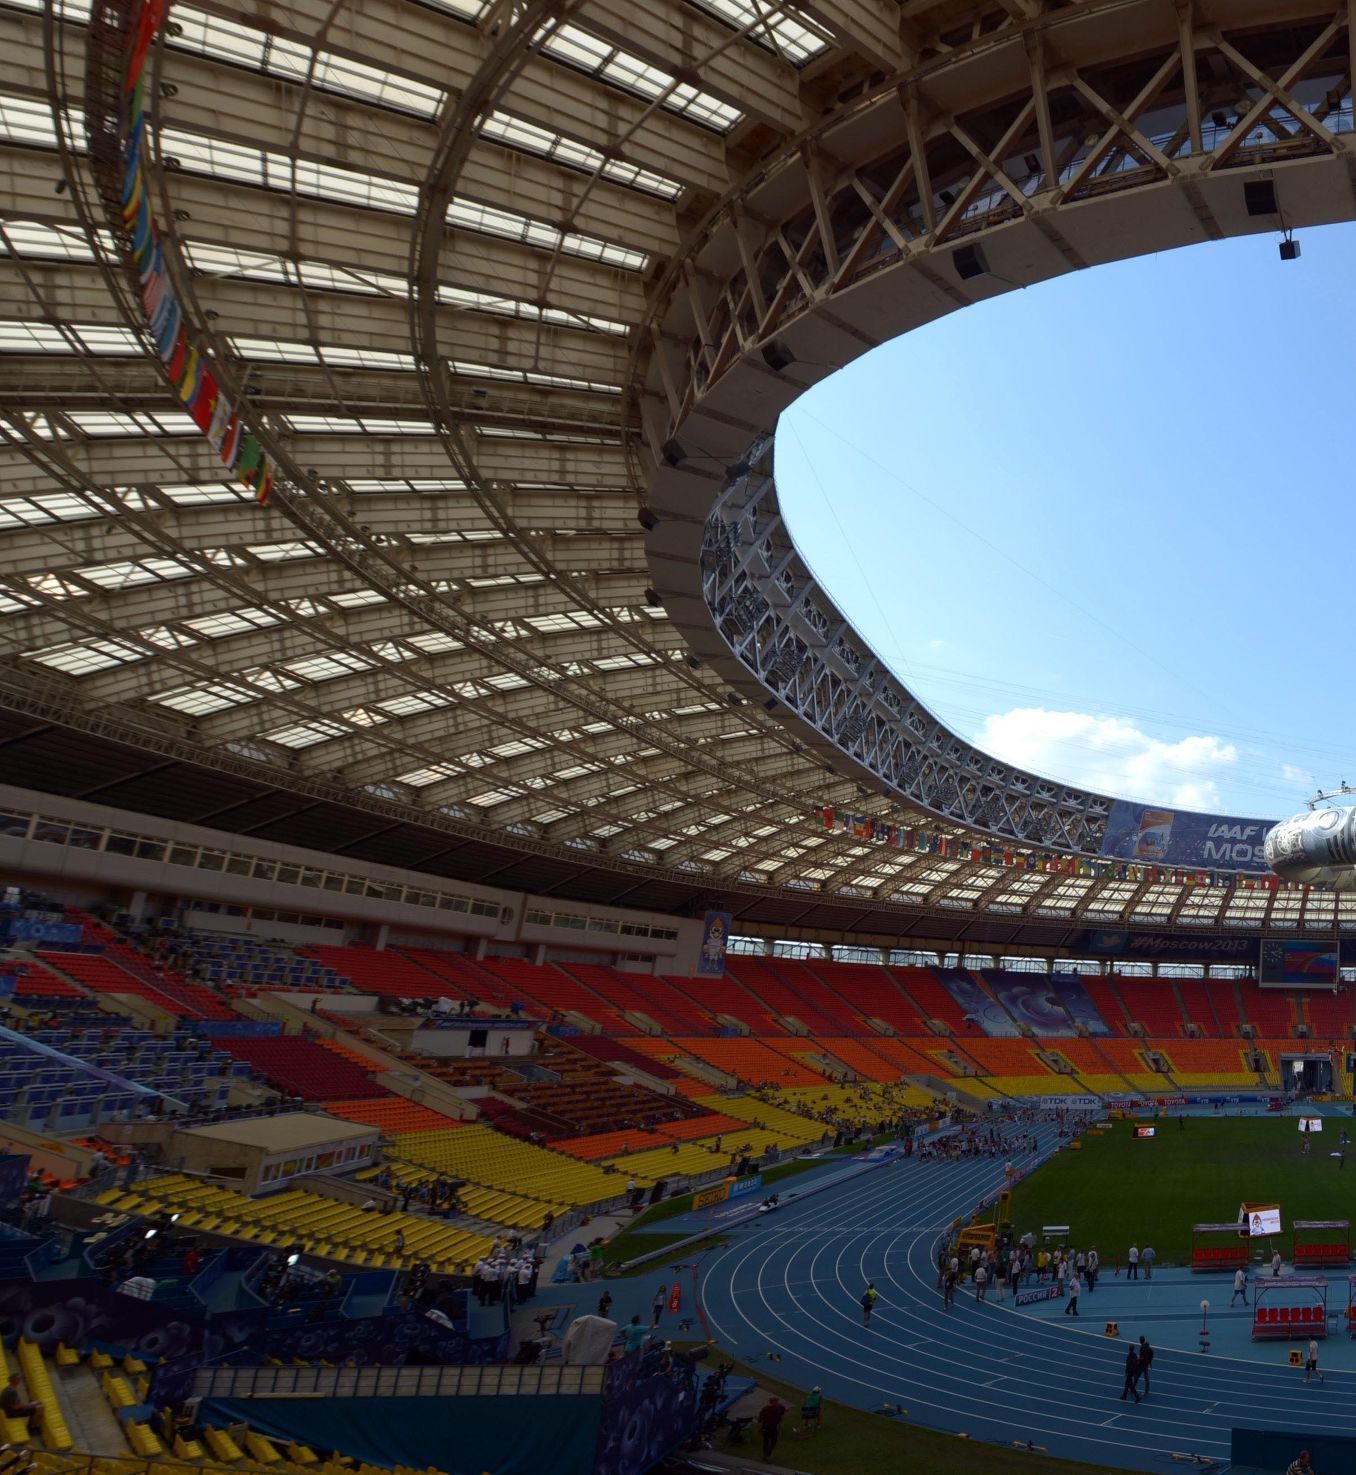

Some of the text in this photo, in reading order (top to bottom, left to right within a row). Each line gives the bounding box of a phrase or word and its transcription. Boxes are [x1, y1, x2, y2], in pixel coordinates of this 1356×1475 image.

[1207, 823, 1259, 840] IAAF
[1129, 935, 1248, 952] #Moscow2013
[1049, 1097, 1097, 1105] TDK TDK
